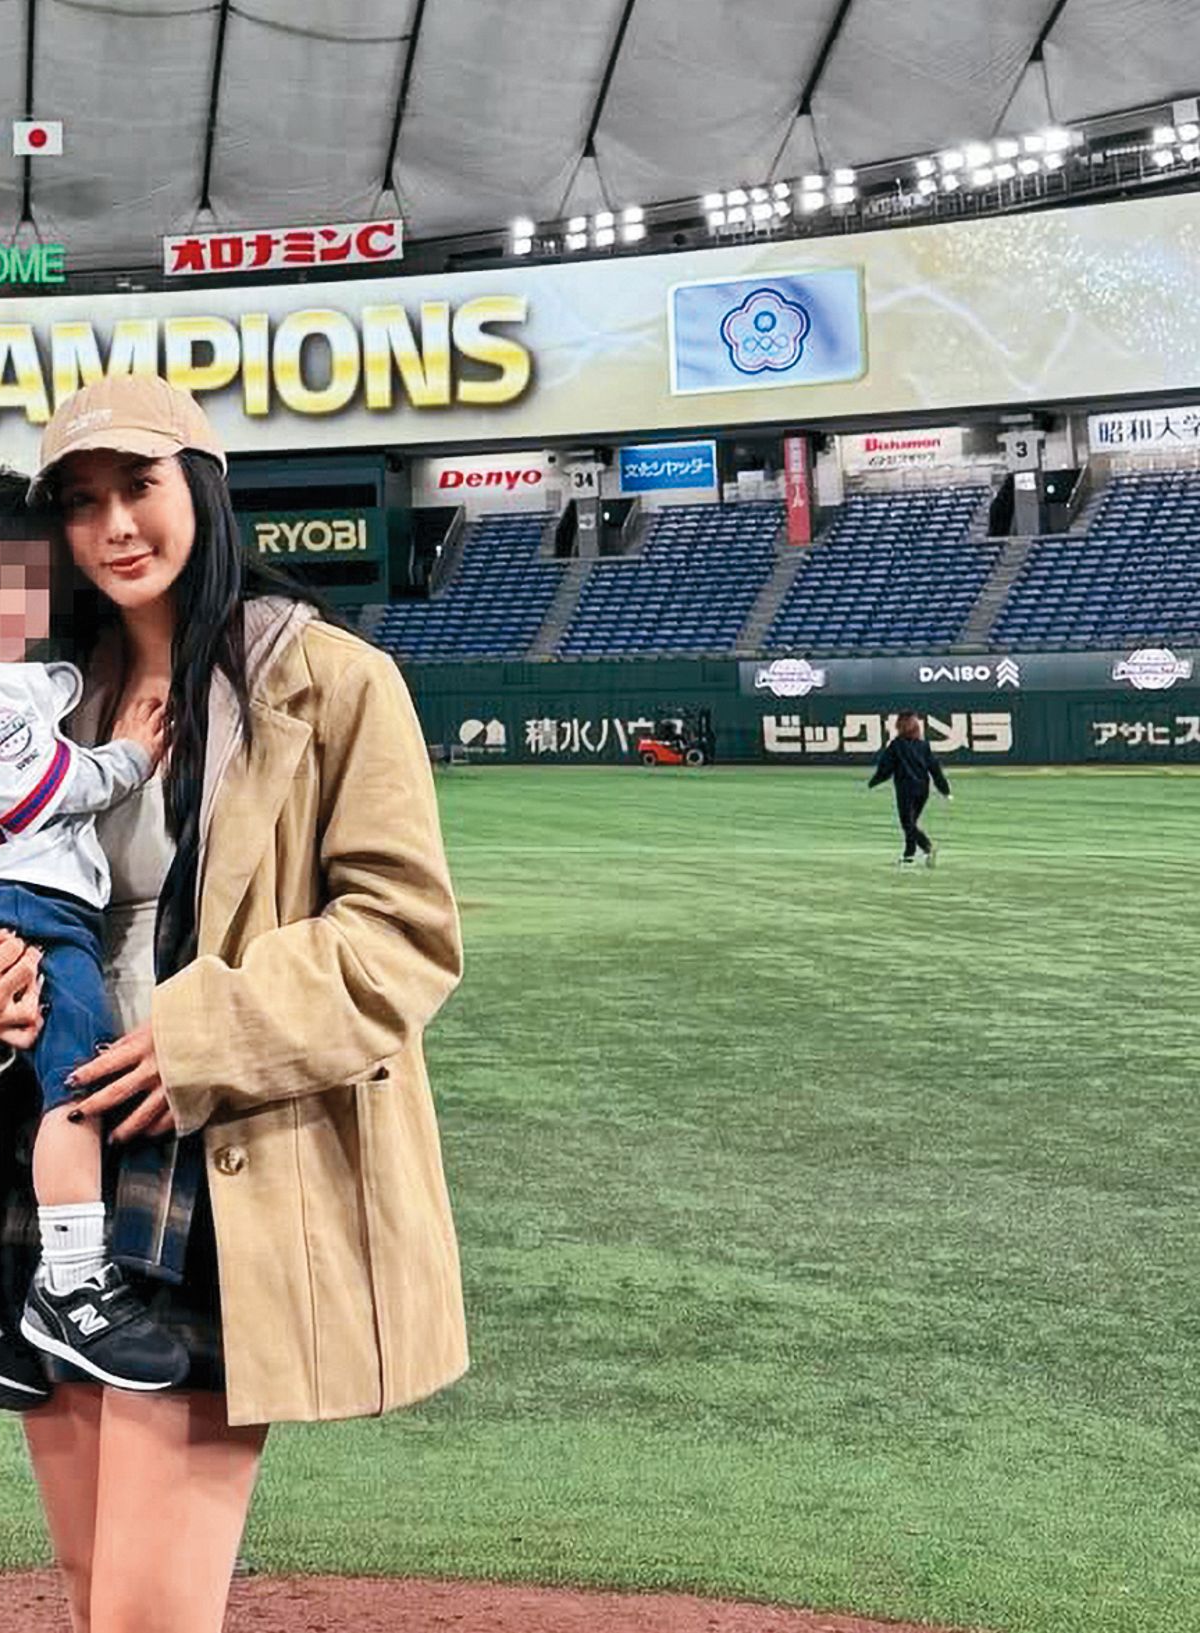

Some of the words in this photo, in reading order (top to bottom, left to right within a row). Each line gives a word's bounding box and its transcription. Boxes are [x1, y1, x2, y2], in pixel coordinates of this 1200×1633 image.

[170, 222, 397, 273] オロナミンC
[1015, 441, 1029, 458] 3
[438, 469, 542, 490] Denyo
[574, 472, 593, 488] 34
[255, 518, 367, 552] RYOBI
